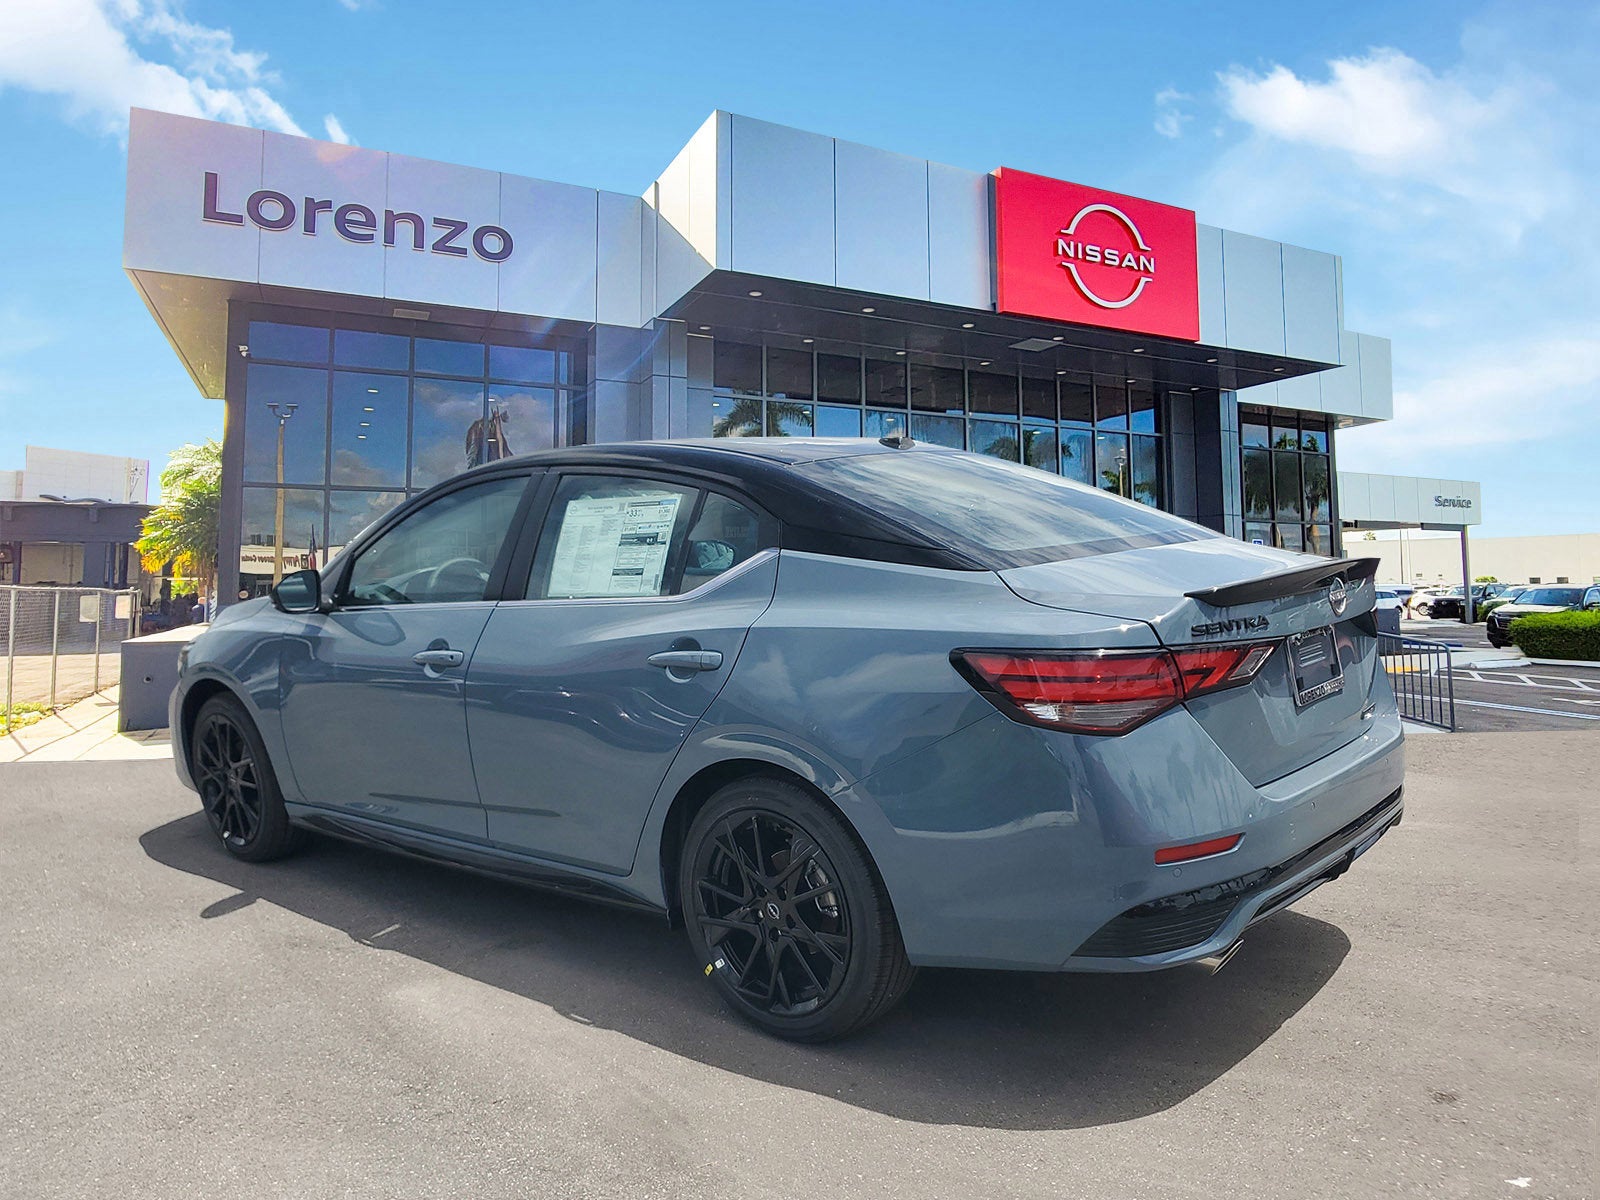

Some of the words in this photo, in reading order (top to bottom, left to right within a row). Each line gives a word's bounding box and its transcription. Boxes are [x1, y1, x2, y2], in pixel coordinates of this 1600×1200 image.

[202, 171, 515, 263] Lorenzo
[1057, 238, 1155, 273] NISSAN
[1434, 495, 1472, 509] Service
[1191, 615, 1270, 637] SENTRA
